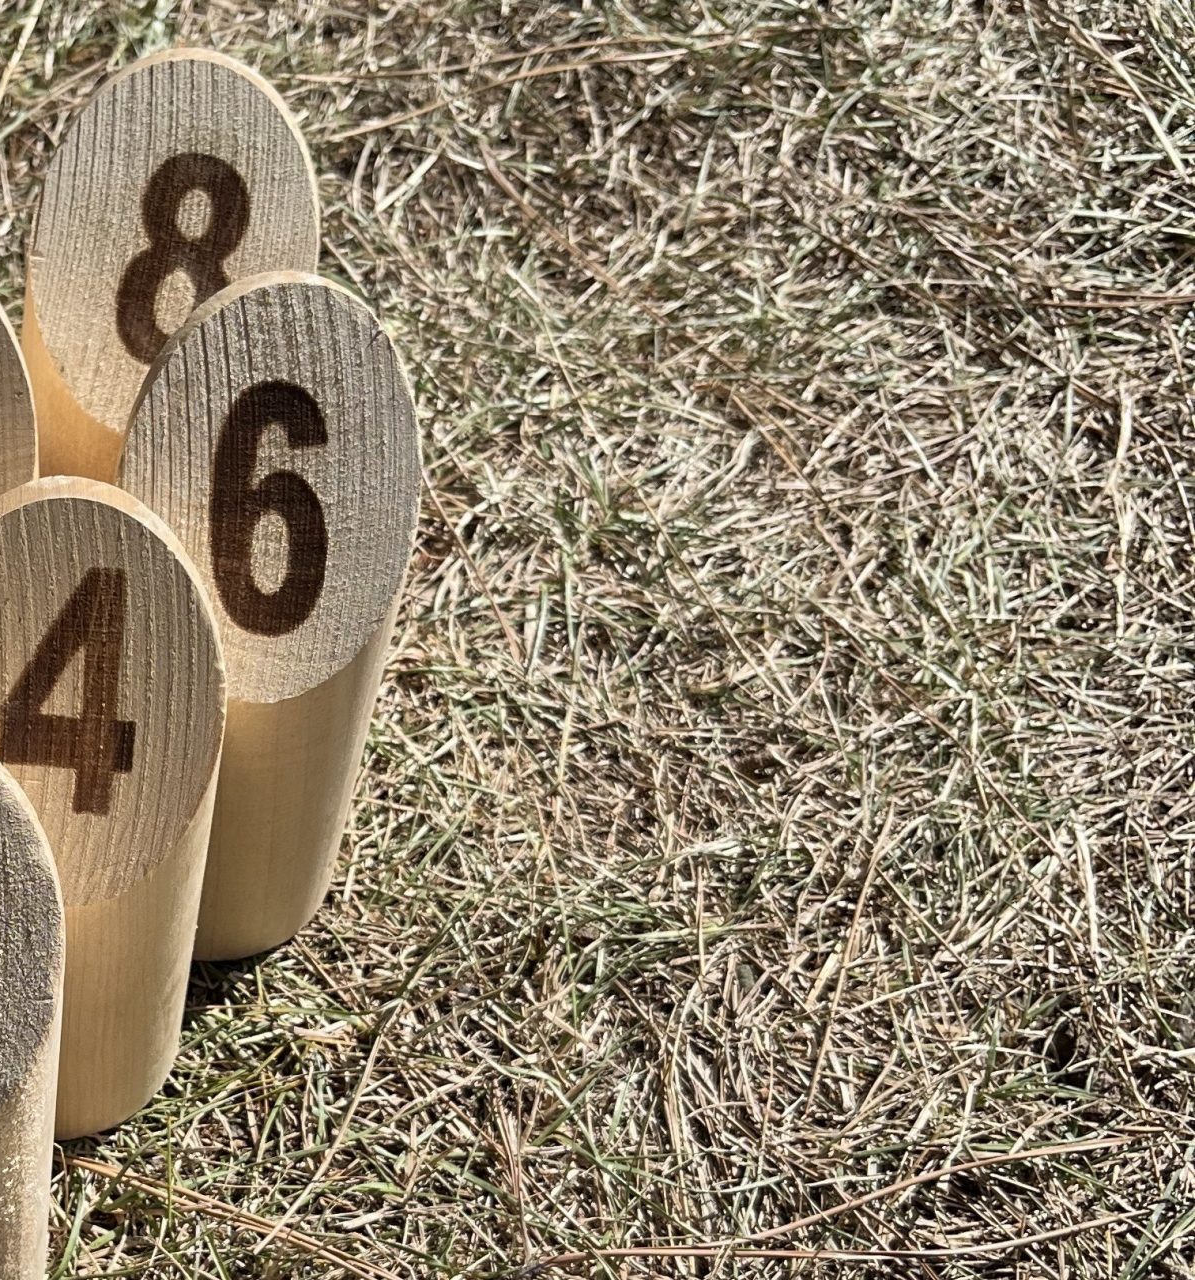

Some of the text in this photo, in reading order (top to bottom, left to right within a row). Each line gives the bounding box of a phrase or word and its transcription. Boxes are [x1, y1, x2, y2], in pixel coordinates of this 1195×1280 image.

[116, 153, 251, 366] 8
[211, 380, 328, 637] 6
[0, 567, 136, 815] 4
